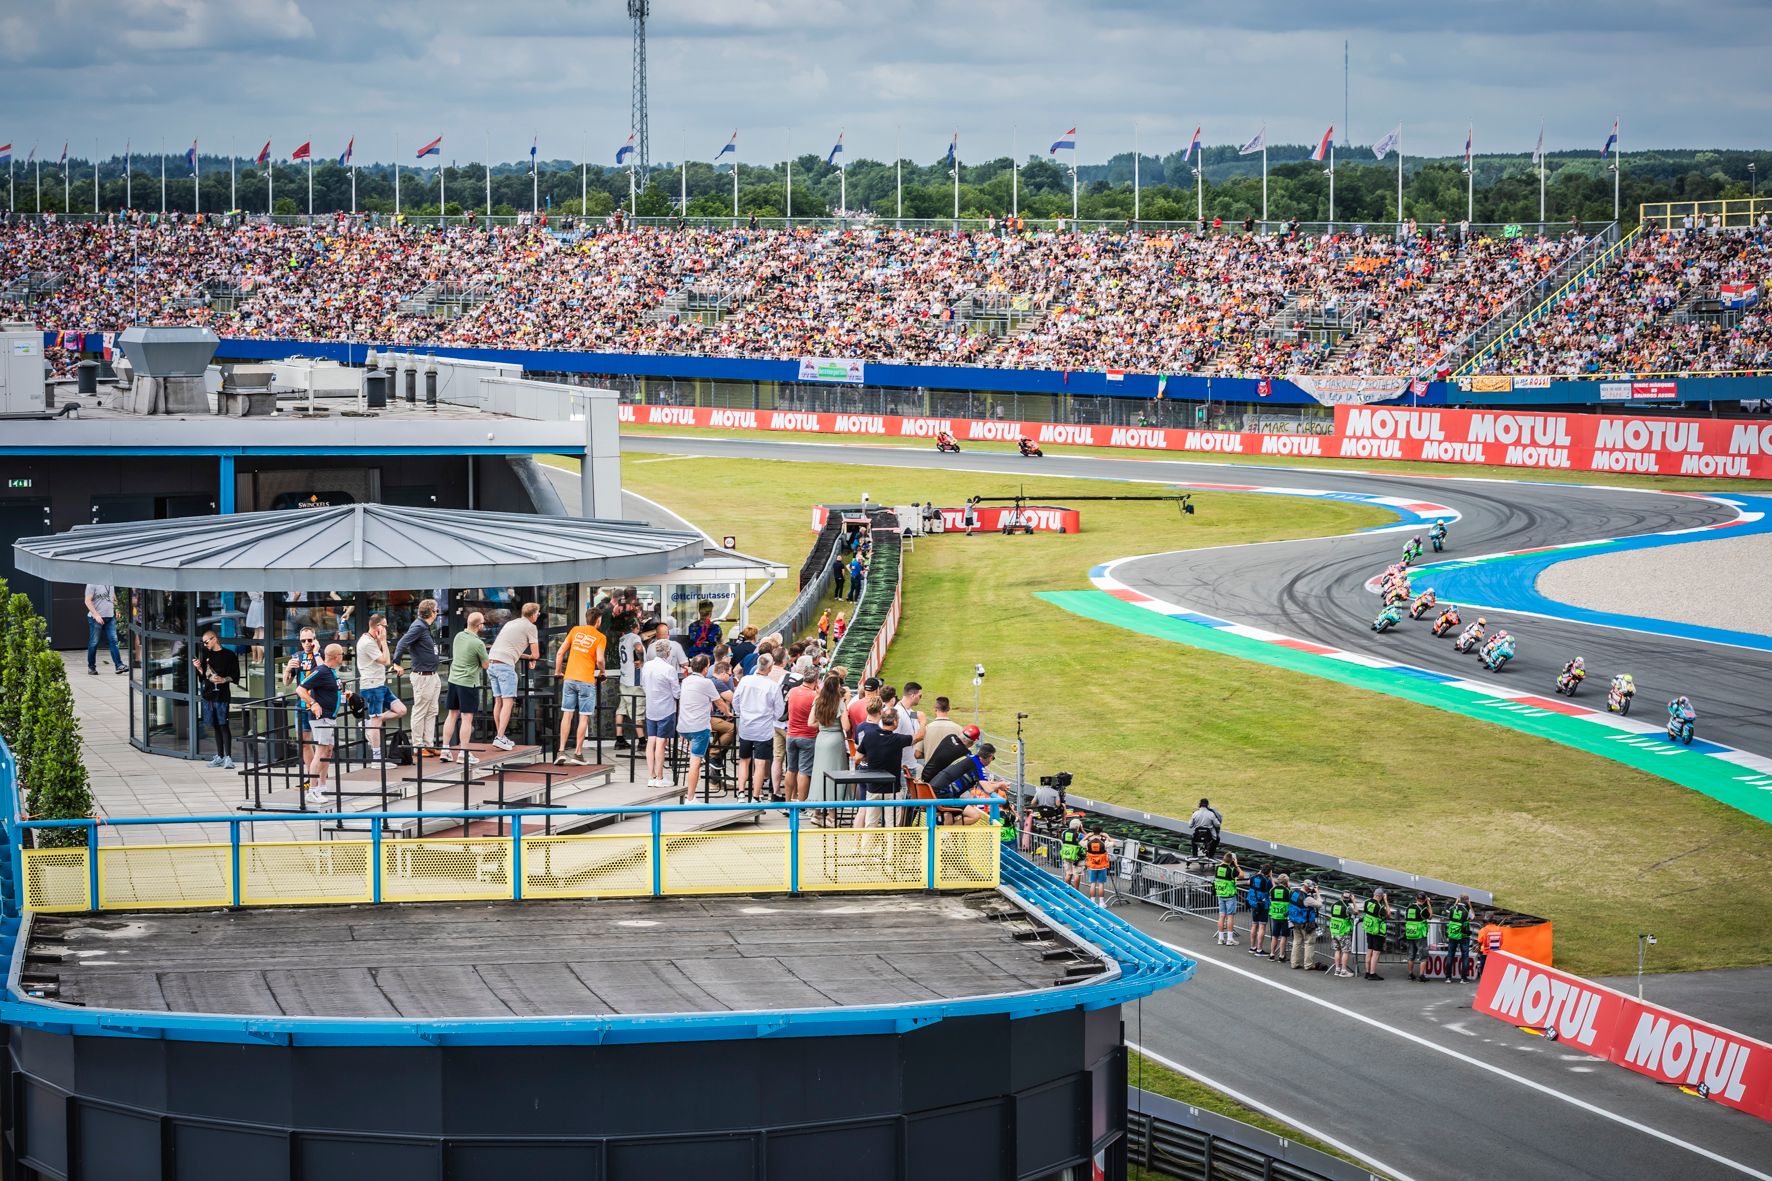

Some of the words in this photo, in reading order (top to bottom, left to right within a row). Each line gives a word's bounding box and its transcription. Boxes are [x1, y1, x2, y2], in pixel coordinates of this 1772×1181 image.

[649, 407, 695, 425] MOTUL
[709, 409, 757, 428] MOTUL
[770, 412, 820, 431] MOTUL
[834, 415, 886, 433] MOTUL
[901, 419, 953, 437] MOTUL
[969, 422, 1023, 440] MOTUL
[1039, 425, 1094, 445] MOTUL
[1110, 427, 1167, 447] MOTUL
[1185, 431, 1243, 452] MOTUL
[1261, 435, 1321, 455] MOTUL
[1262, 422, 1289, 433] MARC
[1345, 409, 1445, 440] MOTUL
[1467, 414, 1571, 446] MOTUL
[1595, 419, 1704, 453] MOTUL
[1340, 437, 1402, 458] MOTUL
[1421, 441, 1485, 462] MOTUL
[1505, 446, 1570, 468] MOTUL
[1592, 451, 1659, 472] MOTUL
[1681, 455, 1751, 475] MOTUL
[943, 511, 981, 529] TUL
[997, 510, 1061, 530] MOTU
[671, 592, 736, 602] @ttcircuitassen
[1490, 963, 1602, 1046] MOTUL
[1624, 1012, 1751, 1102] MOTUL
